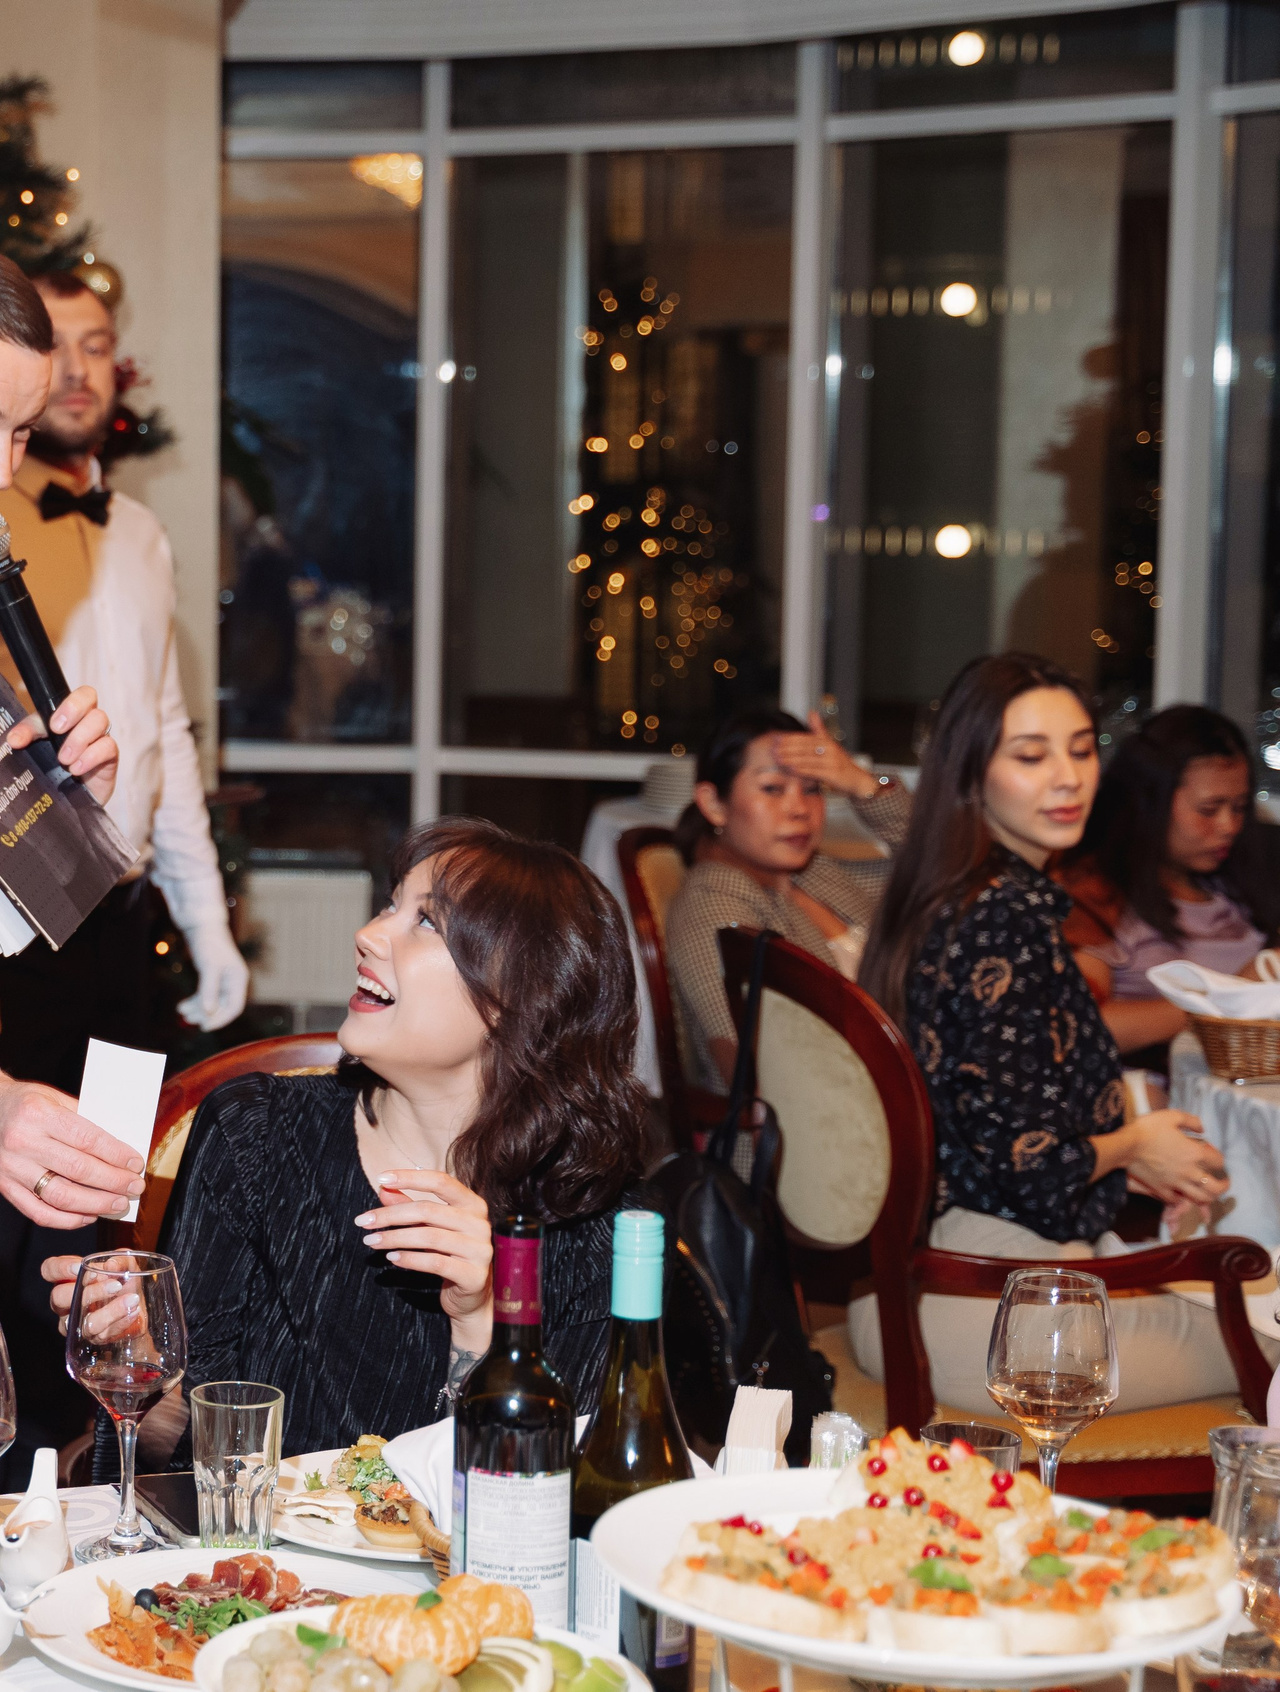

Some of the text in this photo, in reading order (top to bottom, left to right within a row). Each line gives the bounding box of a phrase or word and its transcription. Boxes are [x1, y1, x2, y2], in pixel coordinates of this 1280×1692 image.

[3, 783, 20, 801] для
[13, 769, 34, 791] души
[469, 1560, 567, 1572] ЧРЕЗМЕРНОЕ УПОТРЕБЛЕНИЕ
[472, 1569, 565, 1582] АЛКОГОЛЯ ВРЕДИТ ВАШЕМУ
